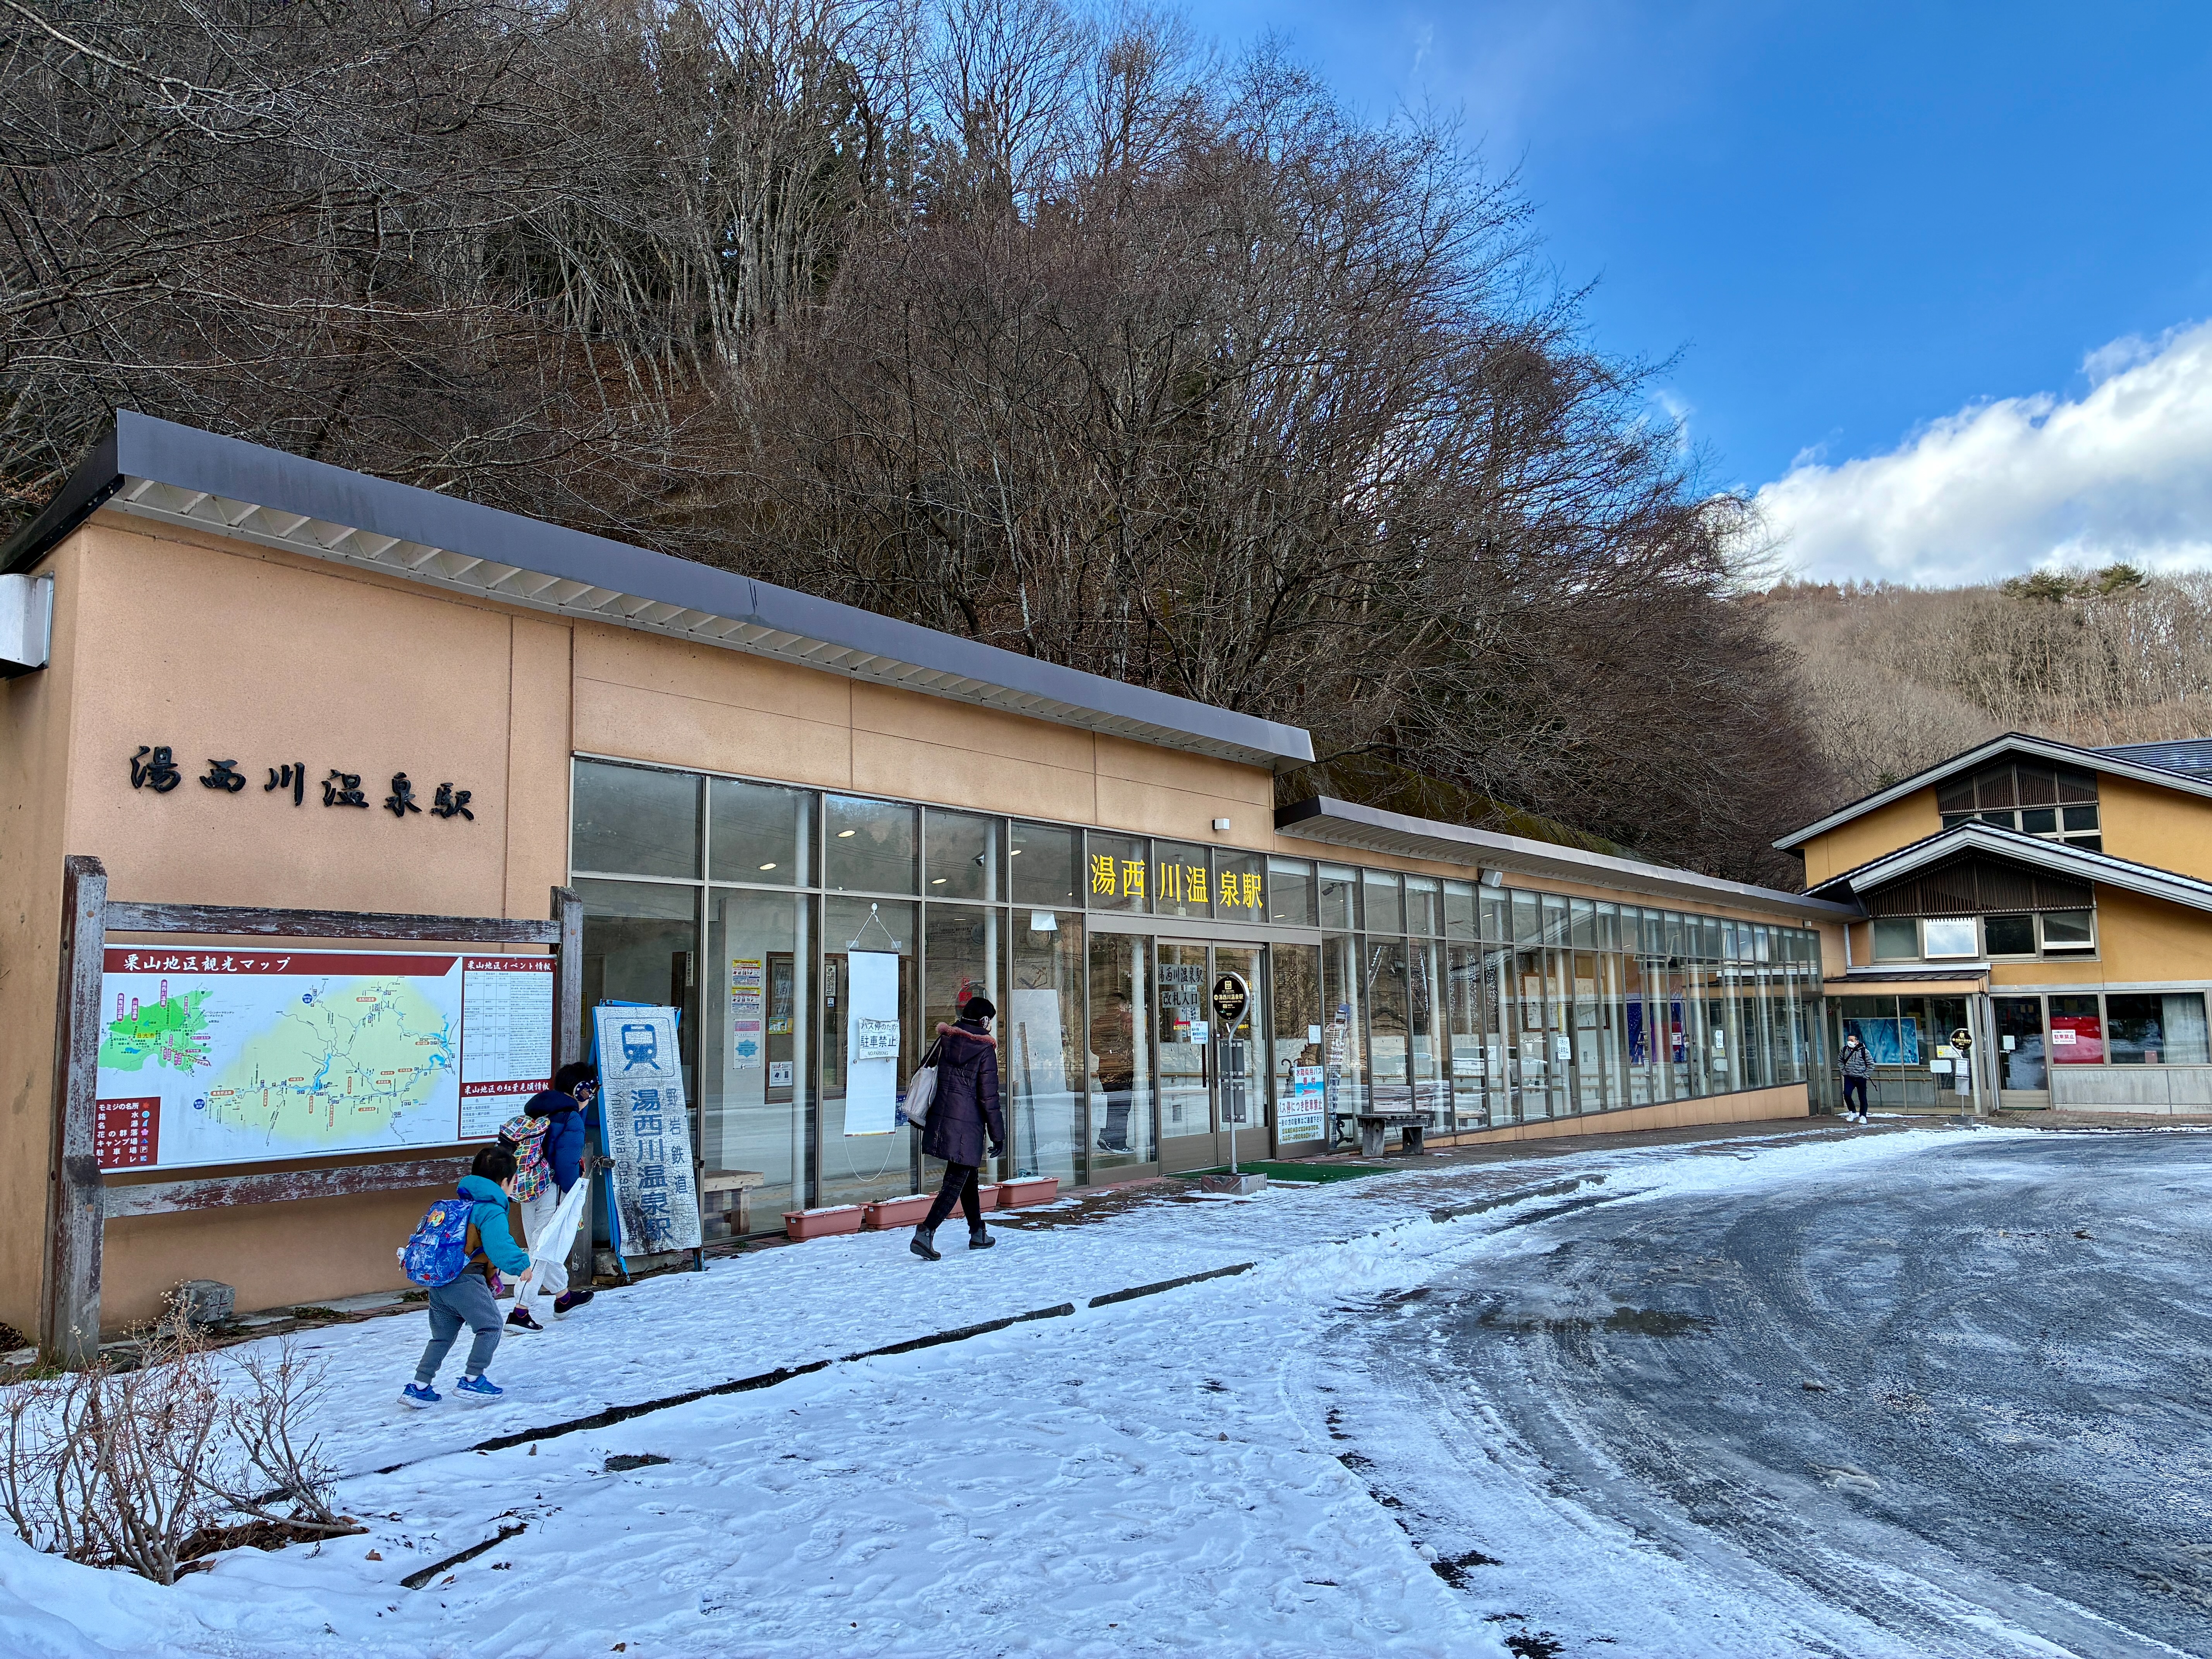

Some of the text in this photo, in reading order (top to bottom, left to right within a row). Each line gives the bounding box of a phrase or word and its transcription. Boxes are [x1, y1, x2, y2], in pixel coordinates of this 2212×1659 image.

[129, 745, 474, 821] 湯西川温泉駅
[1091, 854, 1263, 908] 湯西川温泉駅
[123, 953, 290, 972] 栗山地区観光マップ
[467, 960, 551, 970] 栗山地区イベント情報
[1163, 991, 1198, 1006] 改札入口
[860, 1035, 896, 1048] 駐車禁止
[1296, 1067, 1322, 1077] 水陸両用バス
[464, 1081, 549, 1095] 栗山地区の紅葉見頃情報
[98, 1103, 139, 1111] モミジの名所
[1277, 1098, 1322, 1113] バス停につき駐車禁止
[97, 1128, 139, 1138] 花の群落
[97, 1138, 138, 1147] キャンプ場
[666, 1088, 688, 1194] 野岩鉄道
[96, 1146, 137, 1156] 駐車場
[98, 1156, 136, 1165] トイレ
[631, 1089, 673, 1241] 湯西川温泉駅
